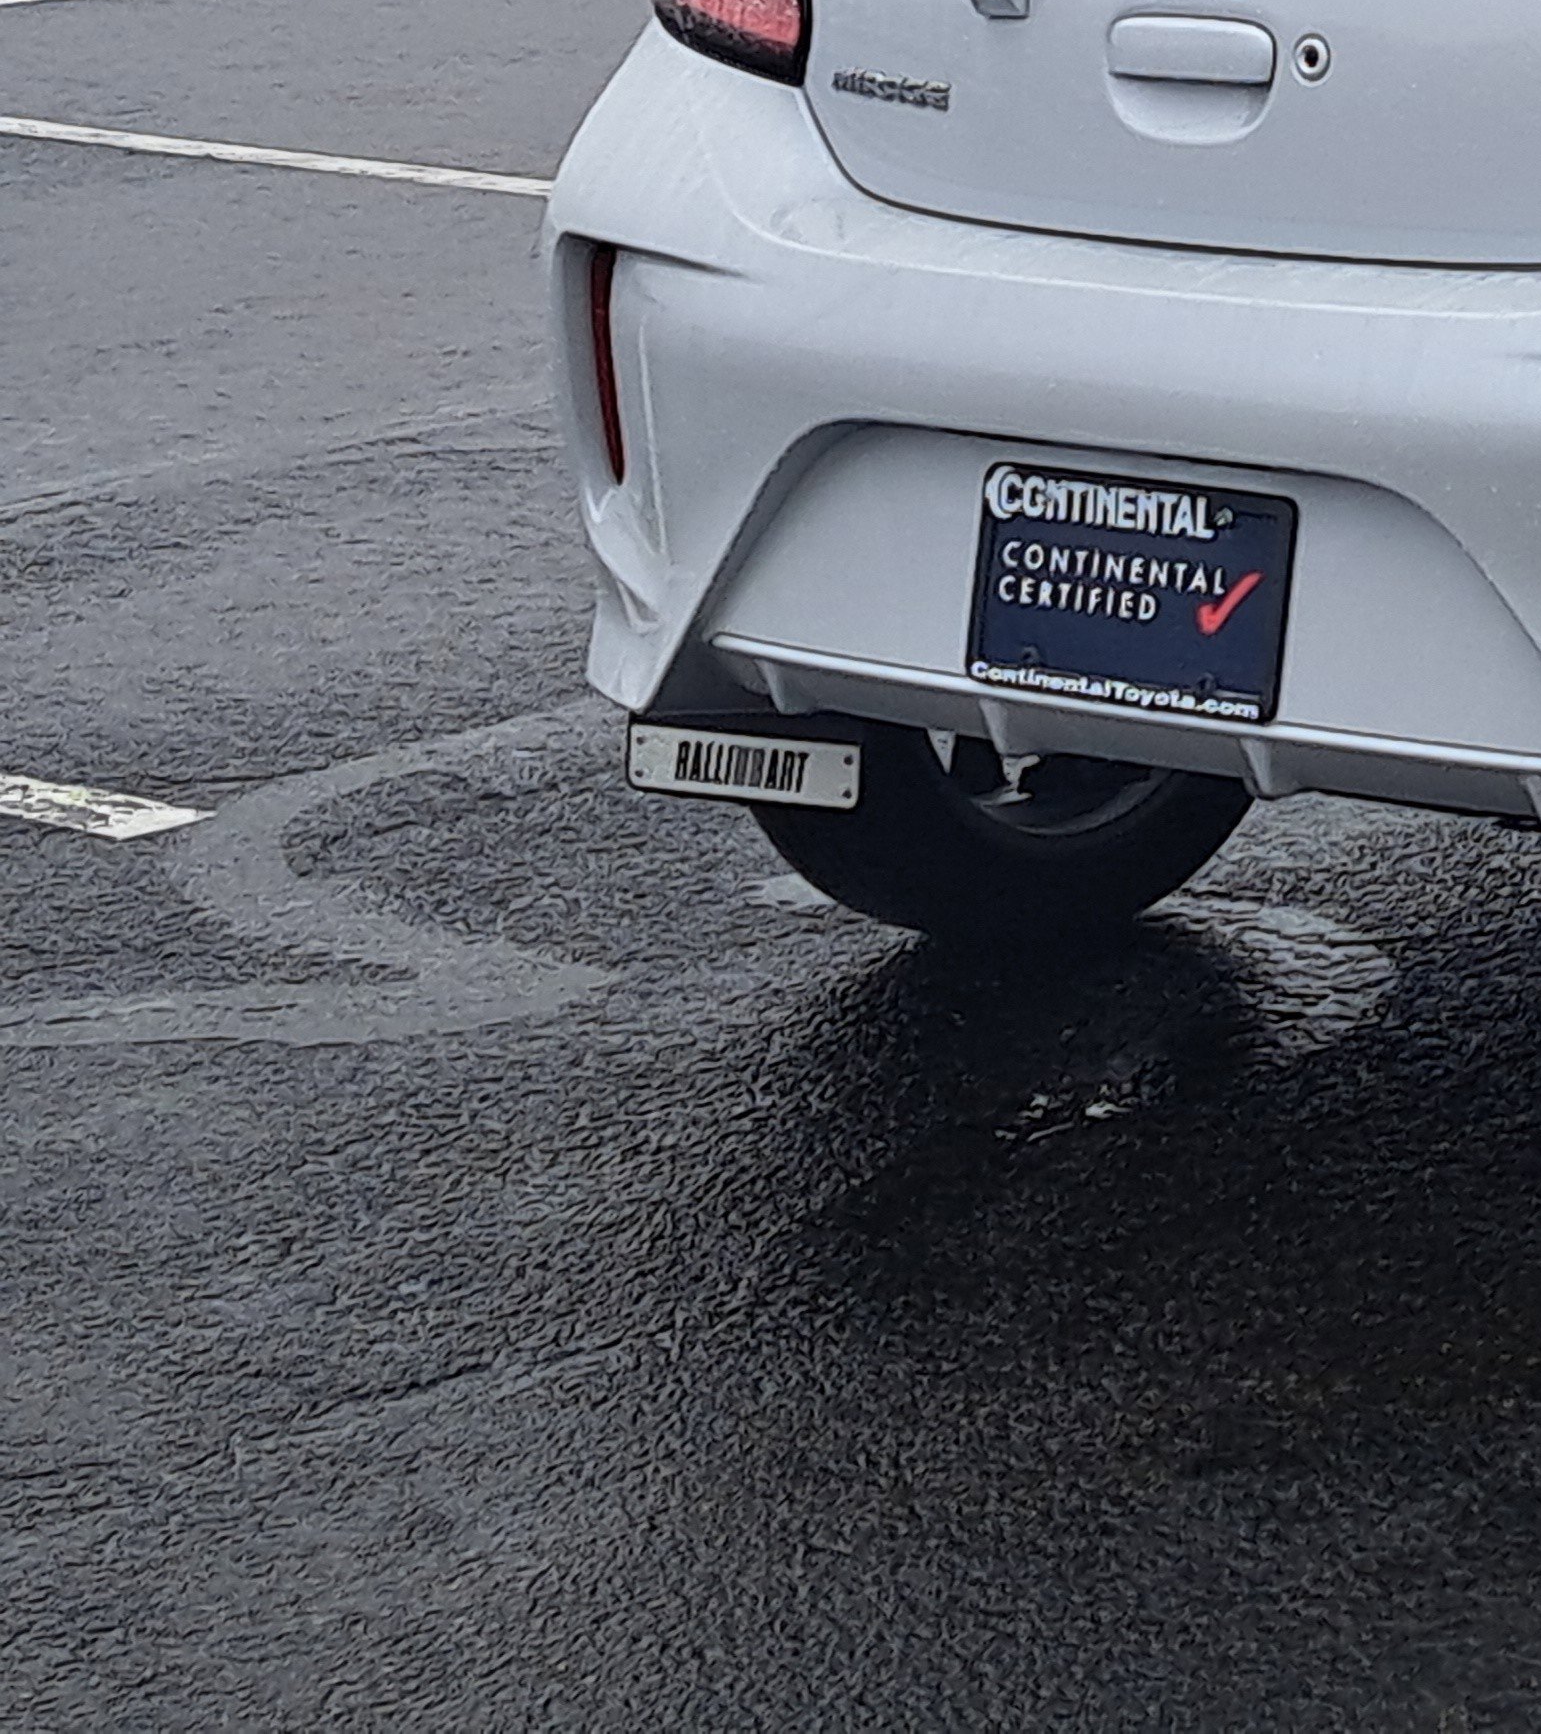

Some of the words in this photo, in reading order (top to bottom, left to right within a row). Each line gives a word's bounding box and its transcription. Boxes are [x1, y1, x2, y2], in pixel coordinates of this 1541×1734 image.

[985, 466, 1215, 539] CONTINENTAL
[1003, 541, 1225, 596] CONTINENTAL
[999, 575, 1157, 621] CERTIFIED
[971, 660, 1260, 719] ContinentalToyota.com
